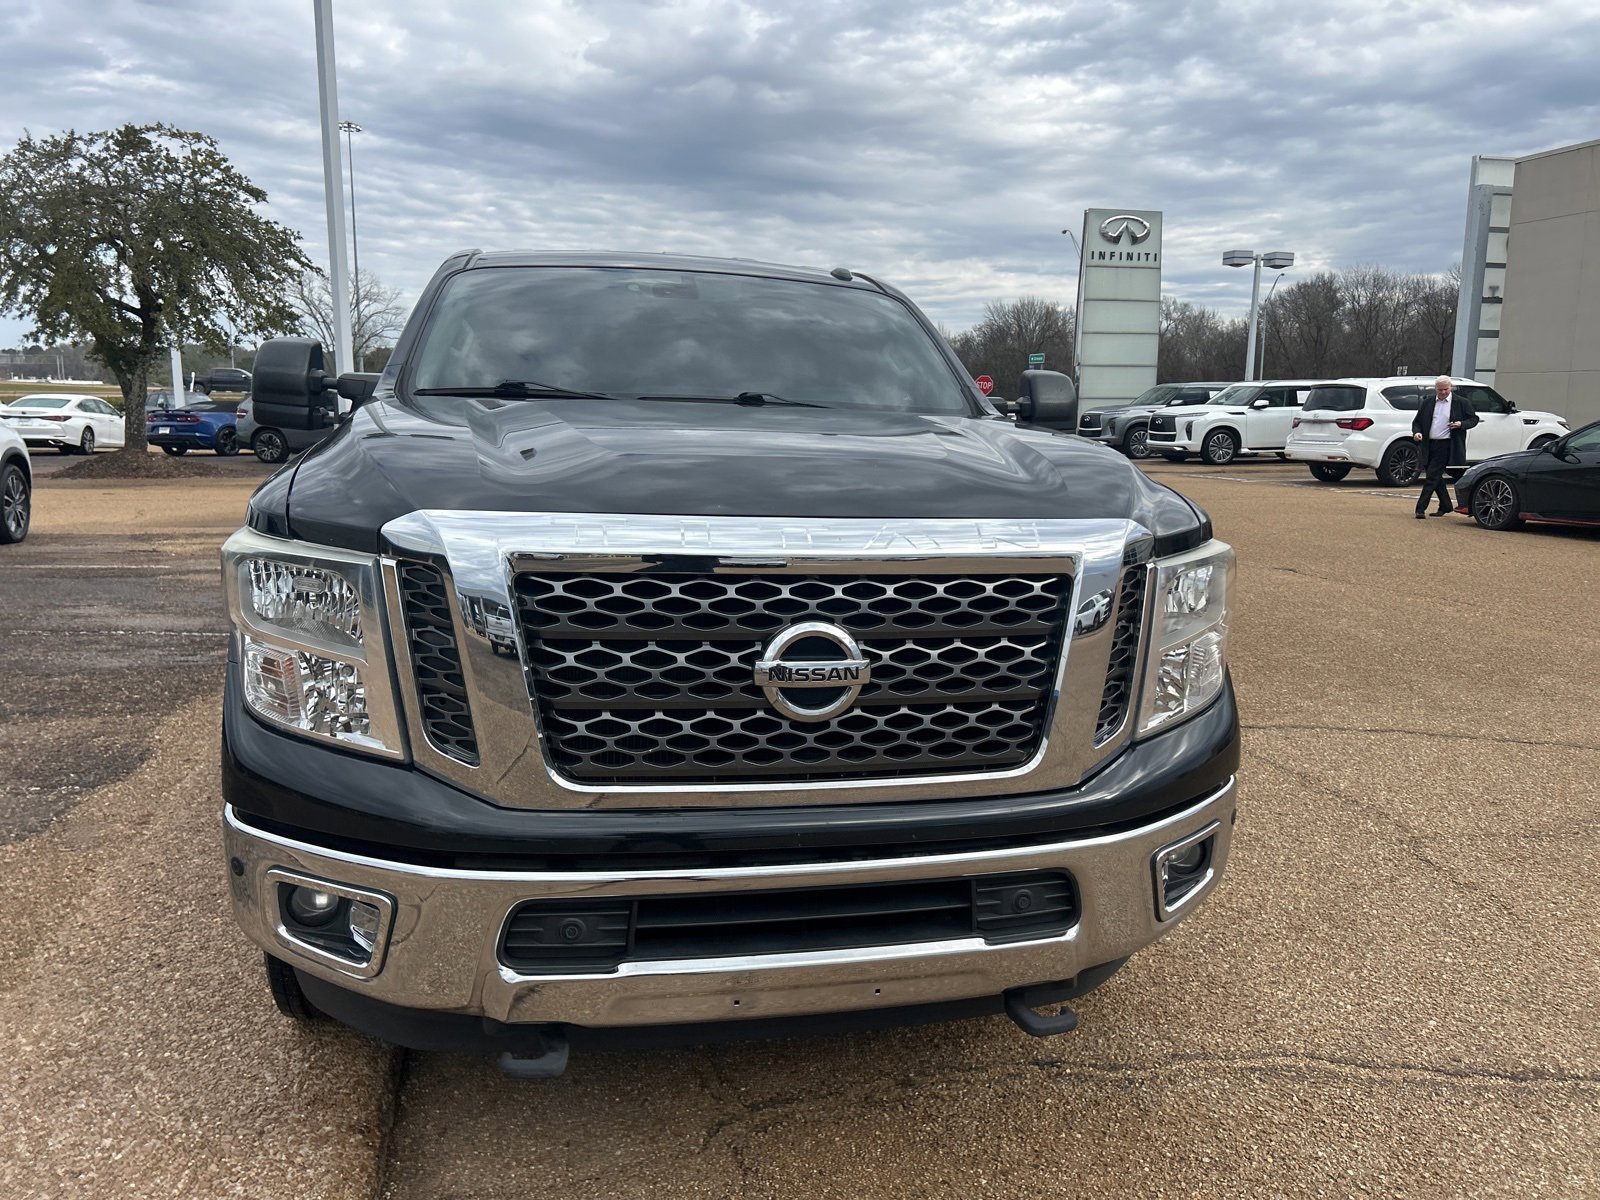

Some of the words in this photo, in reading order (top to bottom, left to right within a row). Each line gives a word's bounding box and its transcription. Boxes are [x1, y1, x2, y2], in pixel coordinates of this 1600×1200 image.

[1091, 250, 1157, 262] INFINITI
[551, 517, 1040, 549] TITAN
[768, 666, 859, 681] NISSAN
